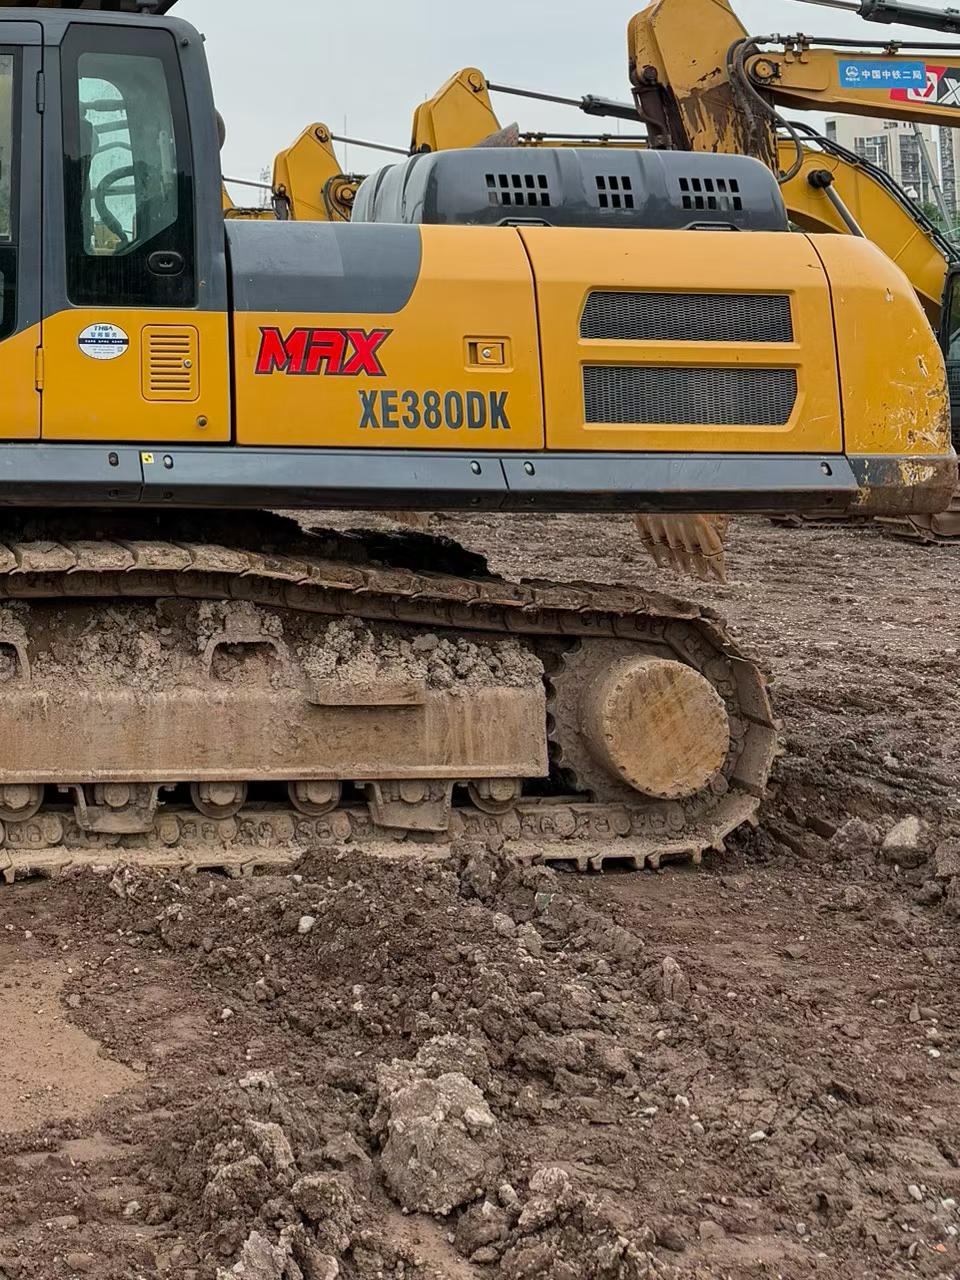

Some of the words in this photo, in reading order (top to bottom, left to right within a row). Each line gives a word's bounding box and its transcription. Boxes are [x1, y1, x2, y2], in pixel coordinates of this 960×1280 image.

[861, 69, 922, 80] 中国中铁二局
[255, 326, 393, 377] MAX
[358, 389, 512, 430] XE380DK
